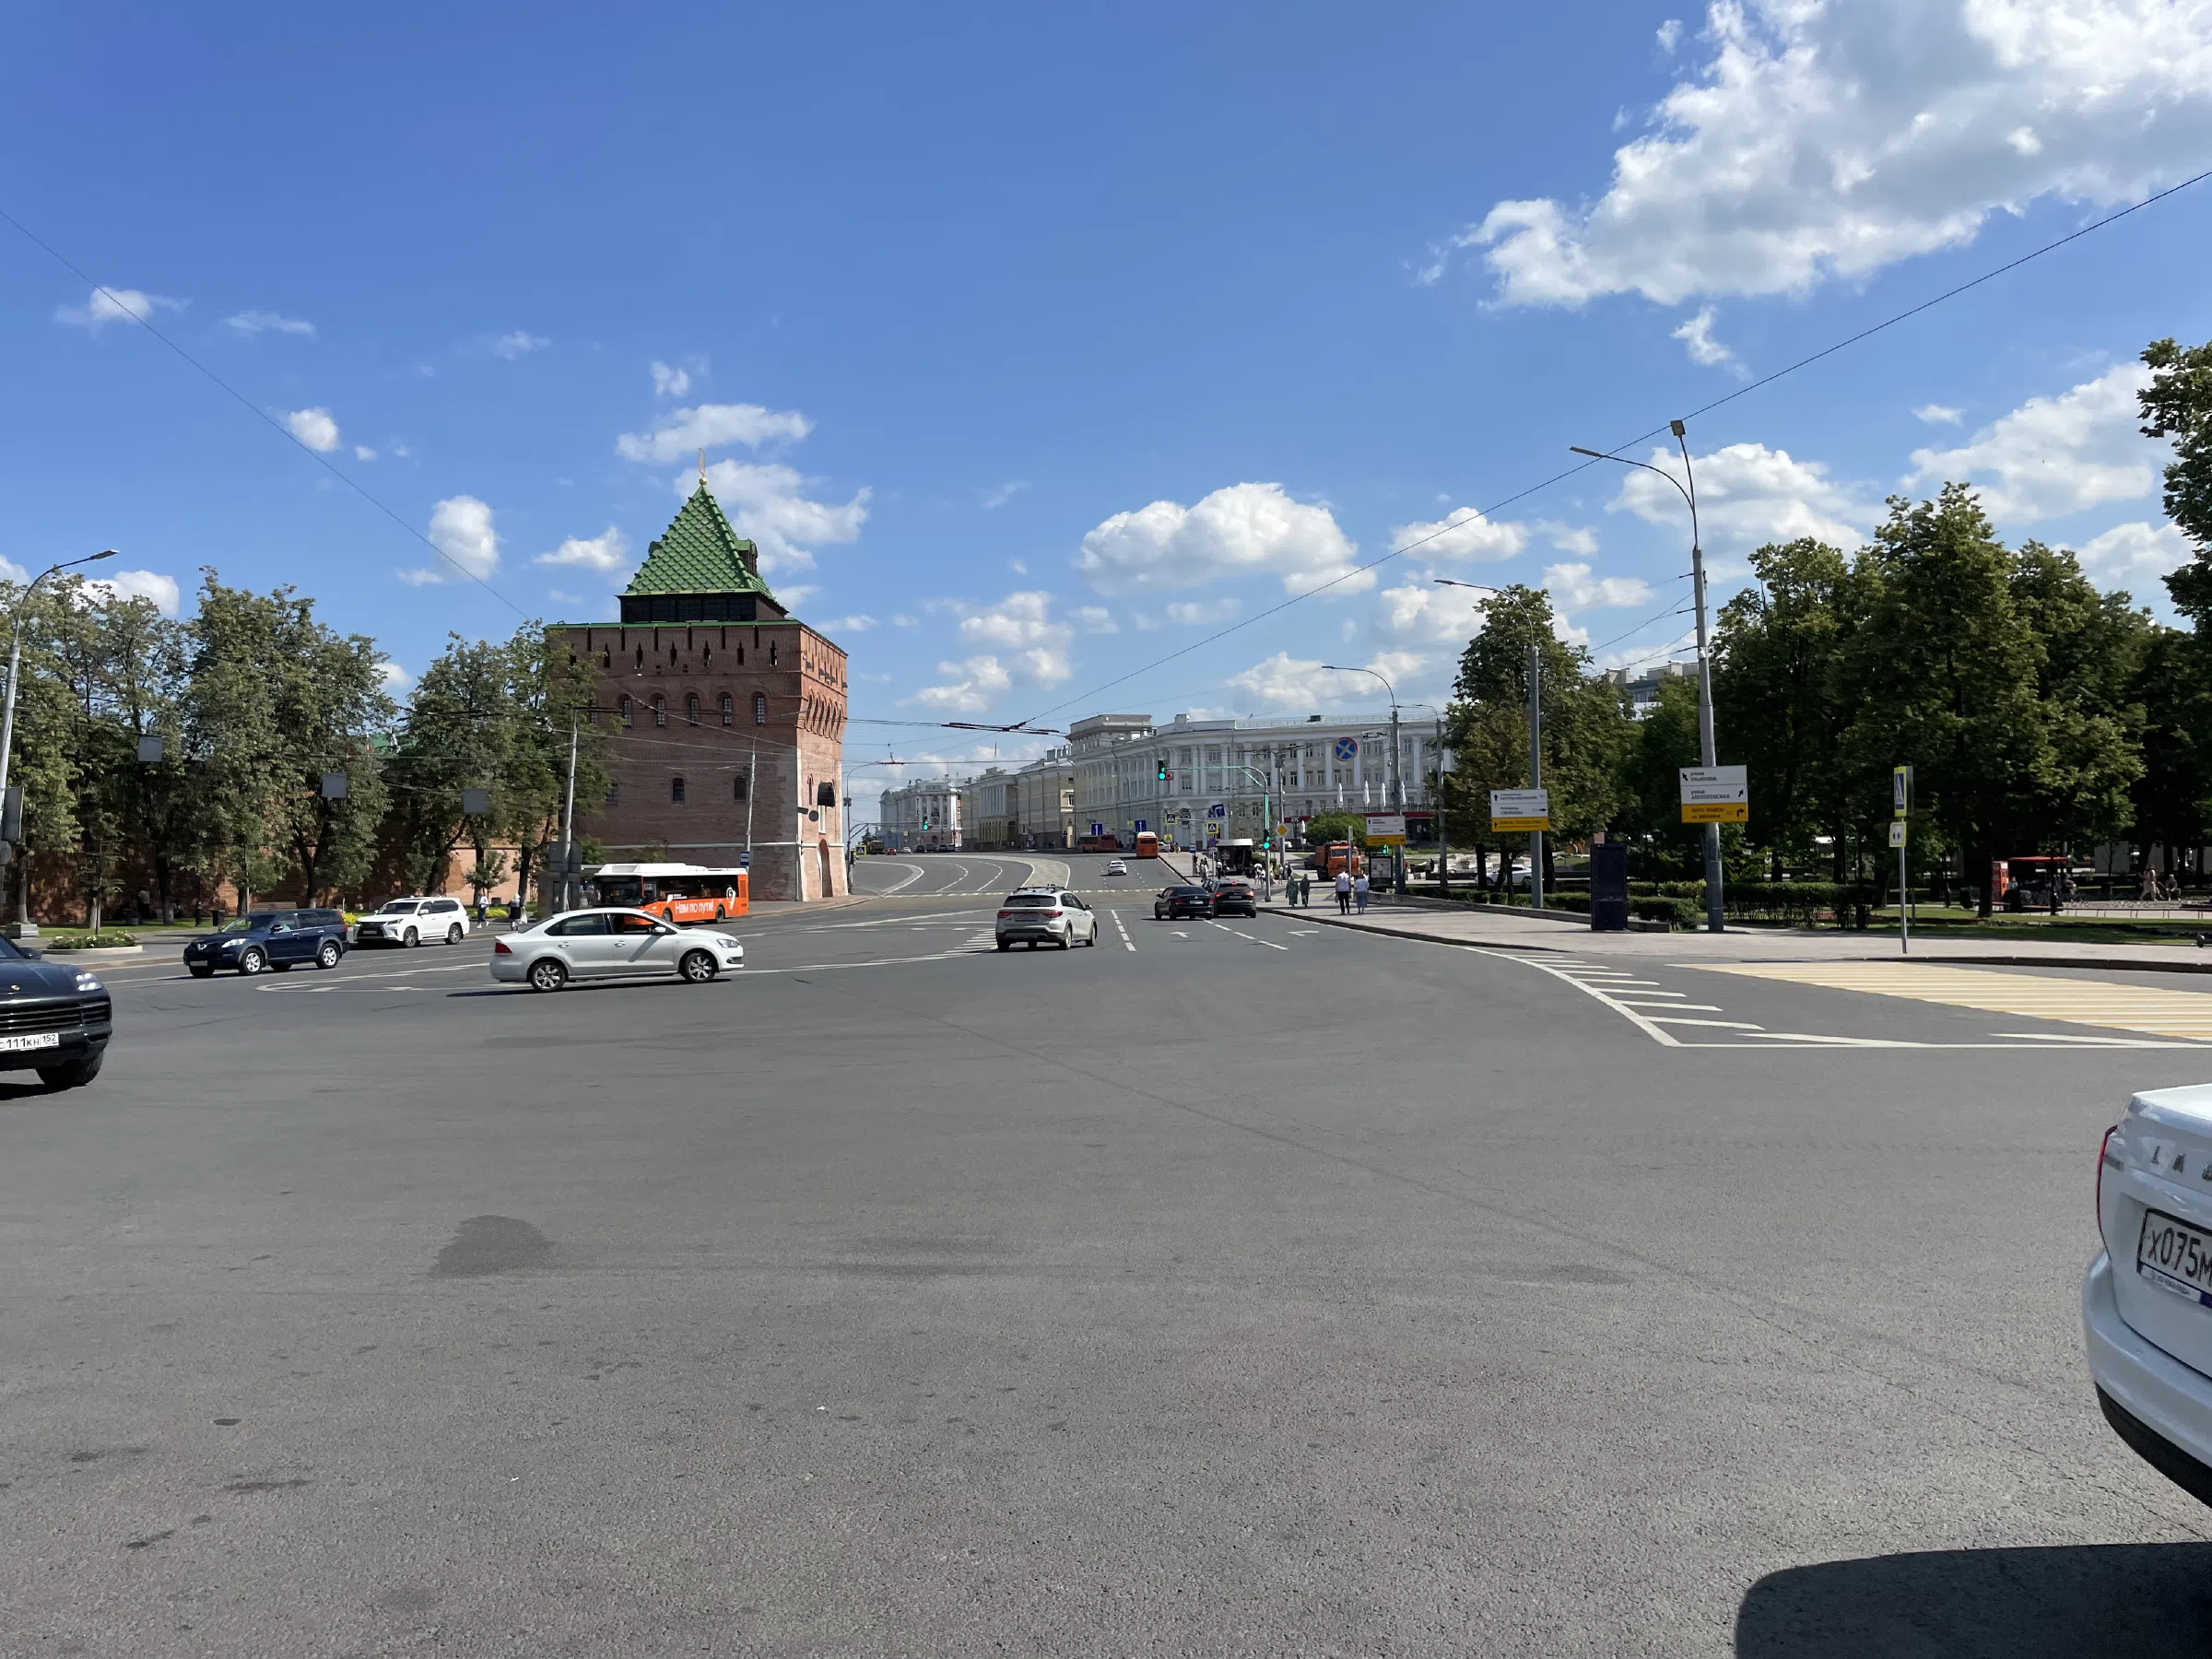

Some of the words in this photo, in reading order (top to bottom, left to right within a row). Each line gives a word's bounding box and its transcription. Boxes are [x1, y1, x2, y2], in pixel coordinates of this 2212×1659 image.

[675, 901, 688, 914] Нам
[689, 903, 698, 912] по
[41, 1034, 56, 1042] 152
